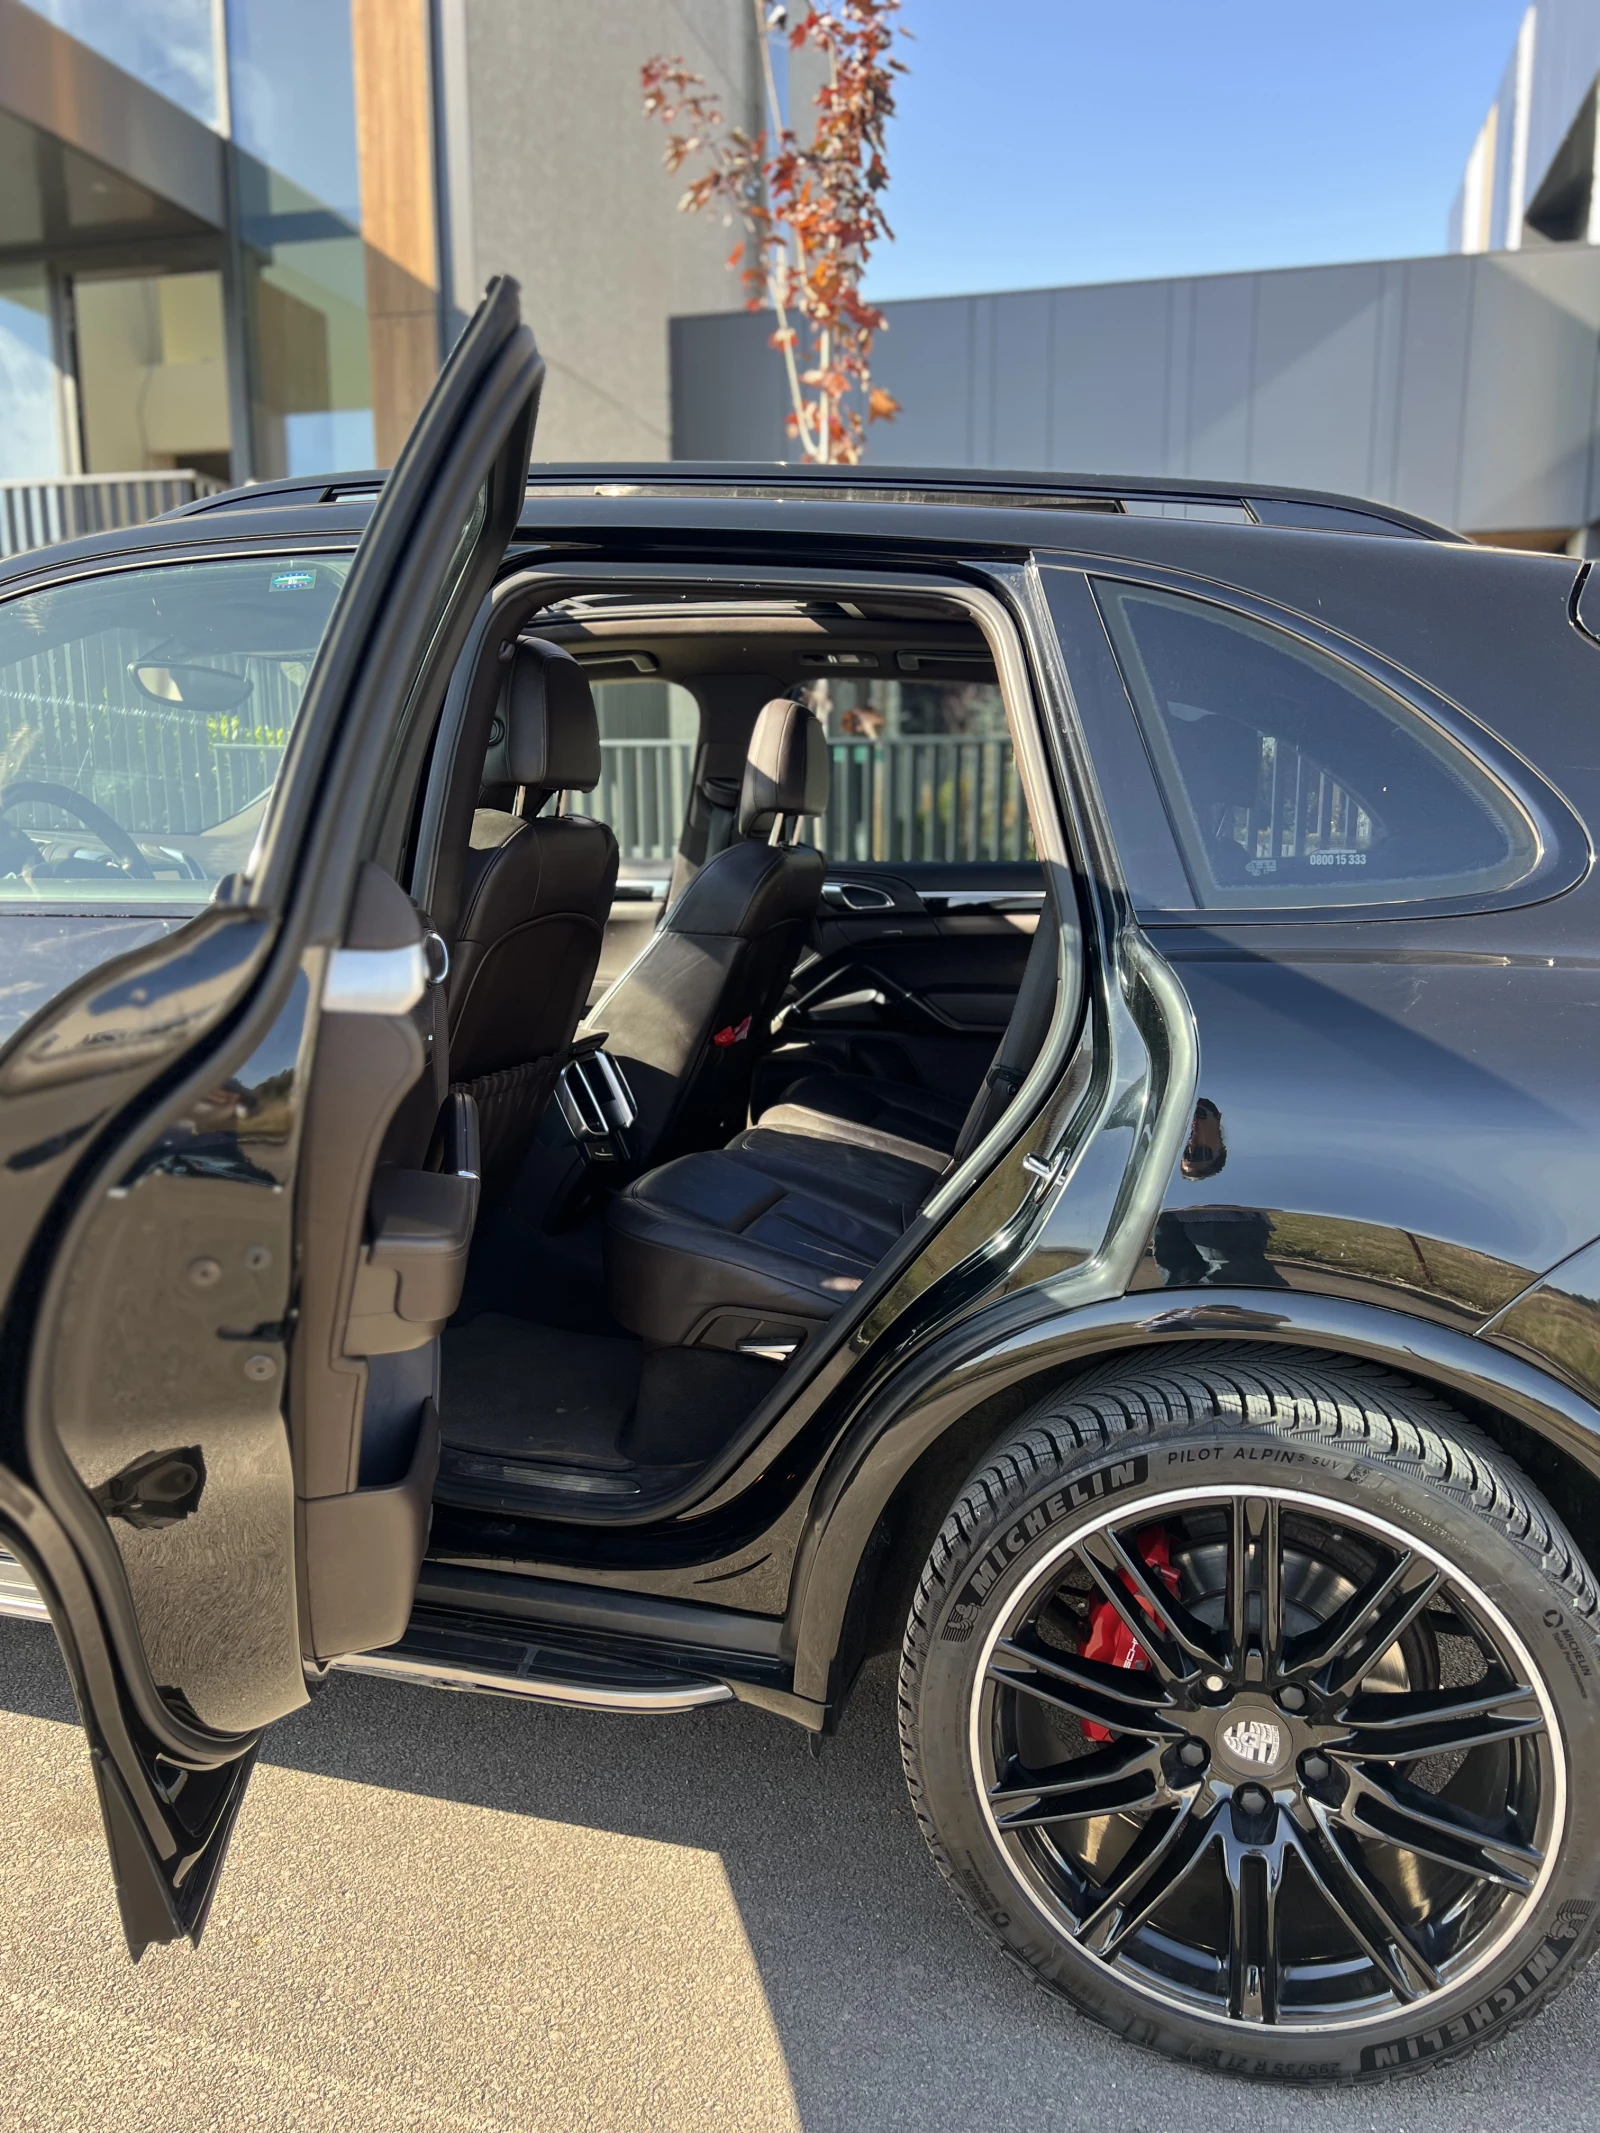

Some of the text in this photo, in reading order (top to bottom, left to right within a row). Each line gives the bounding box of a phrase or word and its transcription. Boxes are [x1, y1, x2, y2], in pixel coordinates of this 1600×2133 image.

[1309, 853, 1367, 865] 0800 15 333
[1167, 1447, 1224, 1465] PILOT
[1312, 1456, 1344, 1470] SUV
[970, 1461, 1136, 1598] MICHELIN
[1552, 1631, 1565, 1652] Total
[1561, 1628, 1592, 1677] MICHELIN
[1374, 1944, 1560, 2068] MICHELIN
